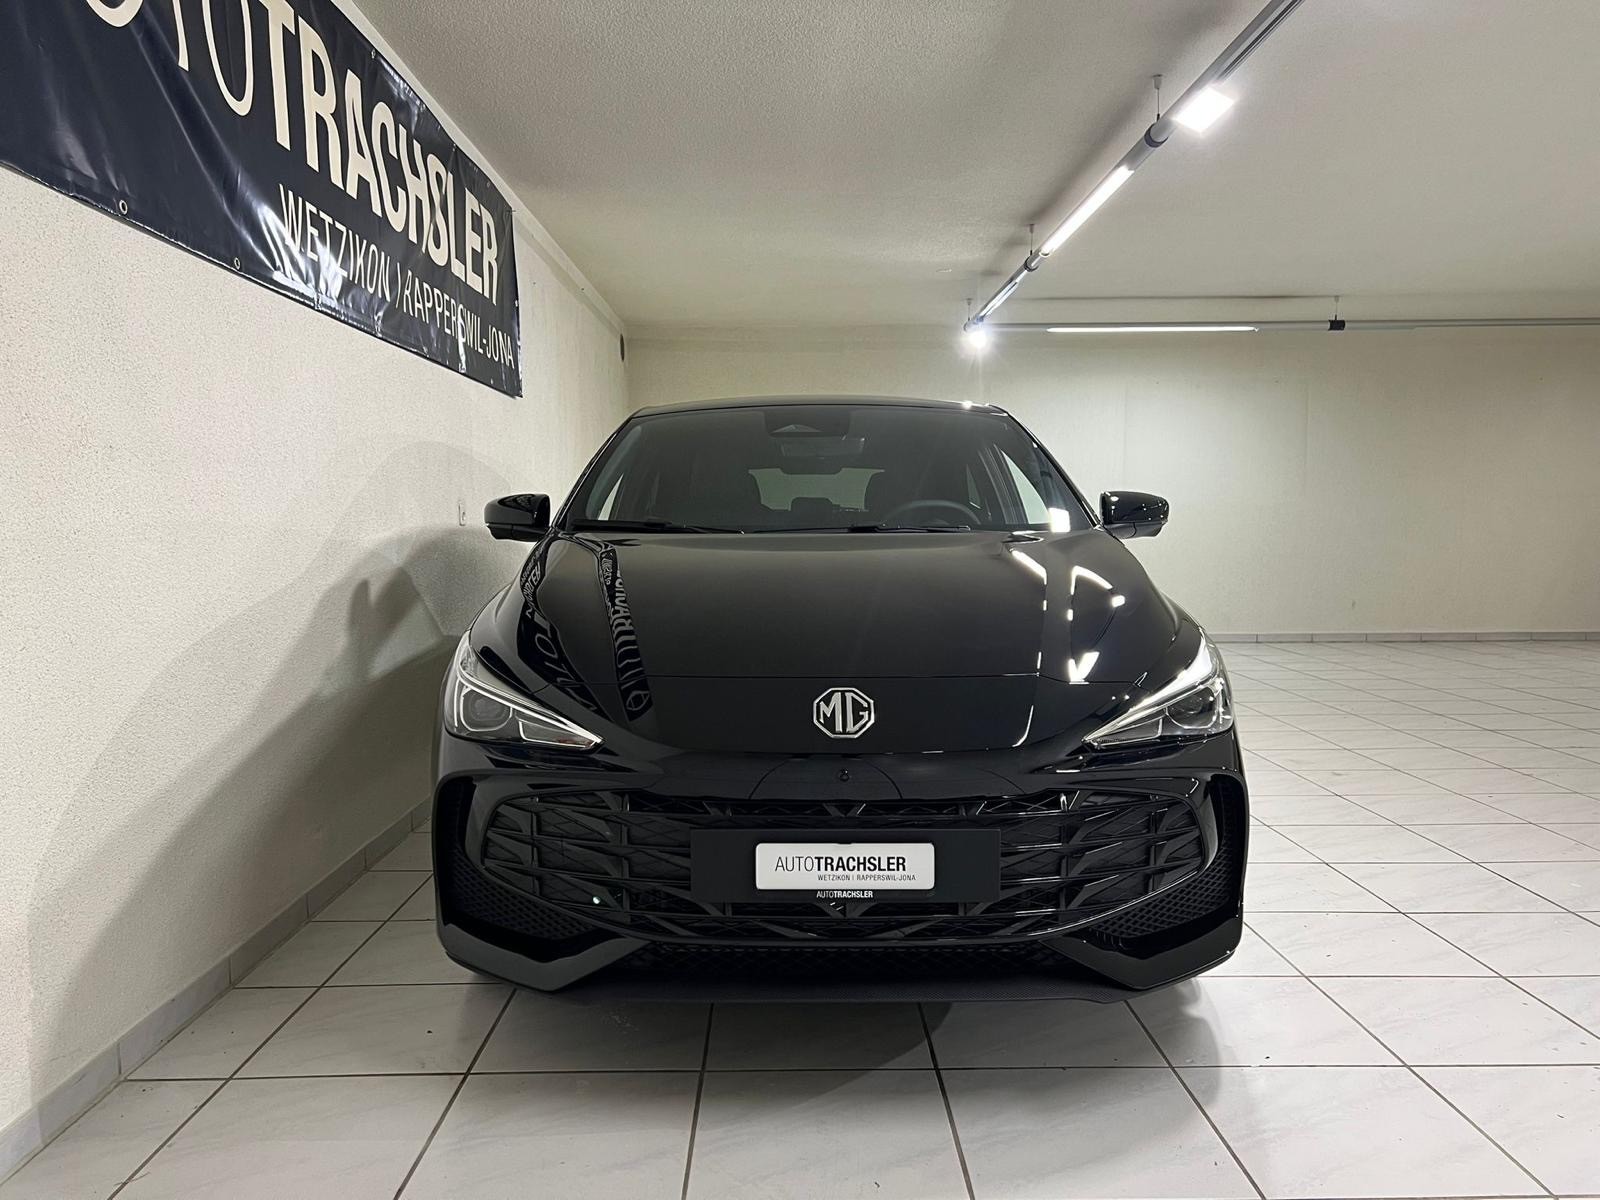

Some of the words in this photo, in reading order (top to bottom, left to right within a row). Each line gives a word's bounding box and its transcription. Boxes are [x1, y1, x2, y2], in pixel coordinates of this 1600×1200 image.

[85, 0, 498, 306] OTRACHSLER
[279, 183, 391, 302] WETZIKON
[403, 268, 515, 370] RAPPERSWIL-JONA
[819, 691, 869, 733] MG
[775, 856, 906, 872] AUTOTRACHSLER
[816, 890, 873, 899] AUTOTRACHSLER
